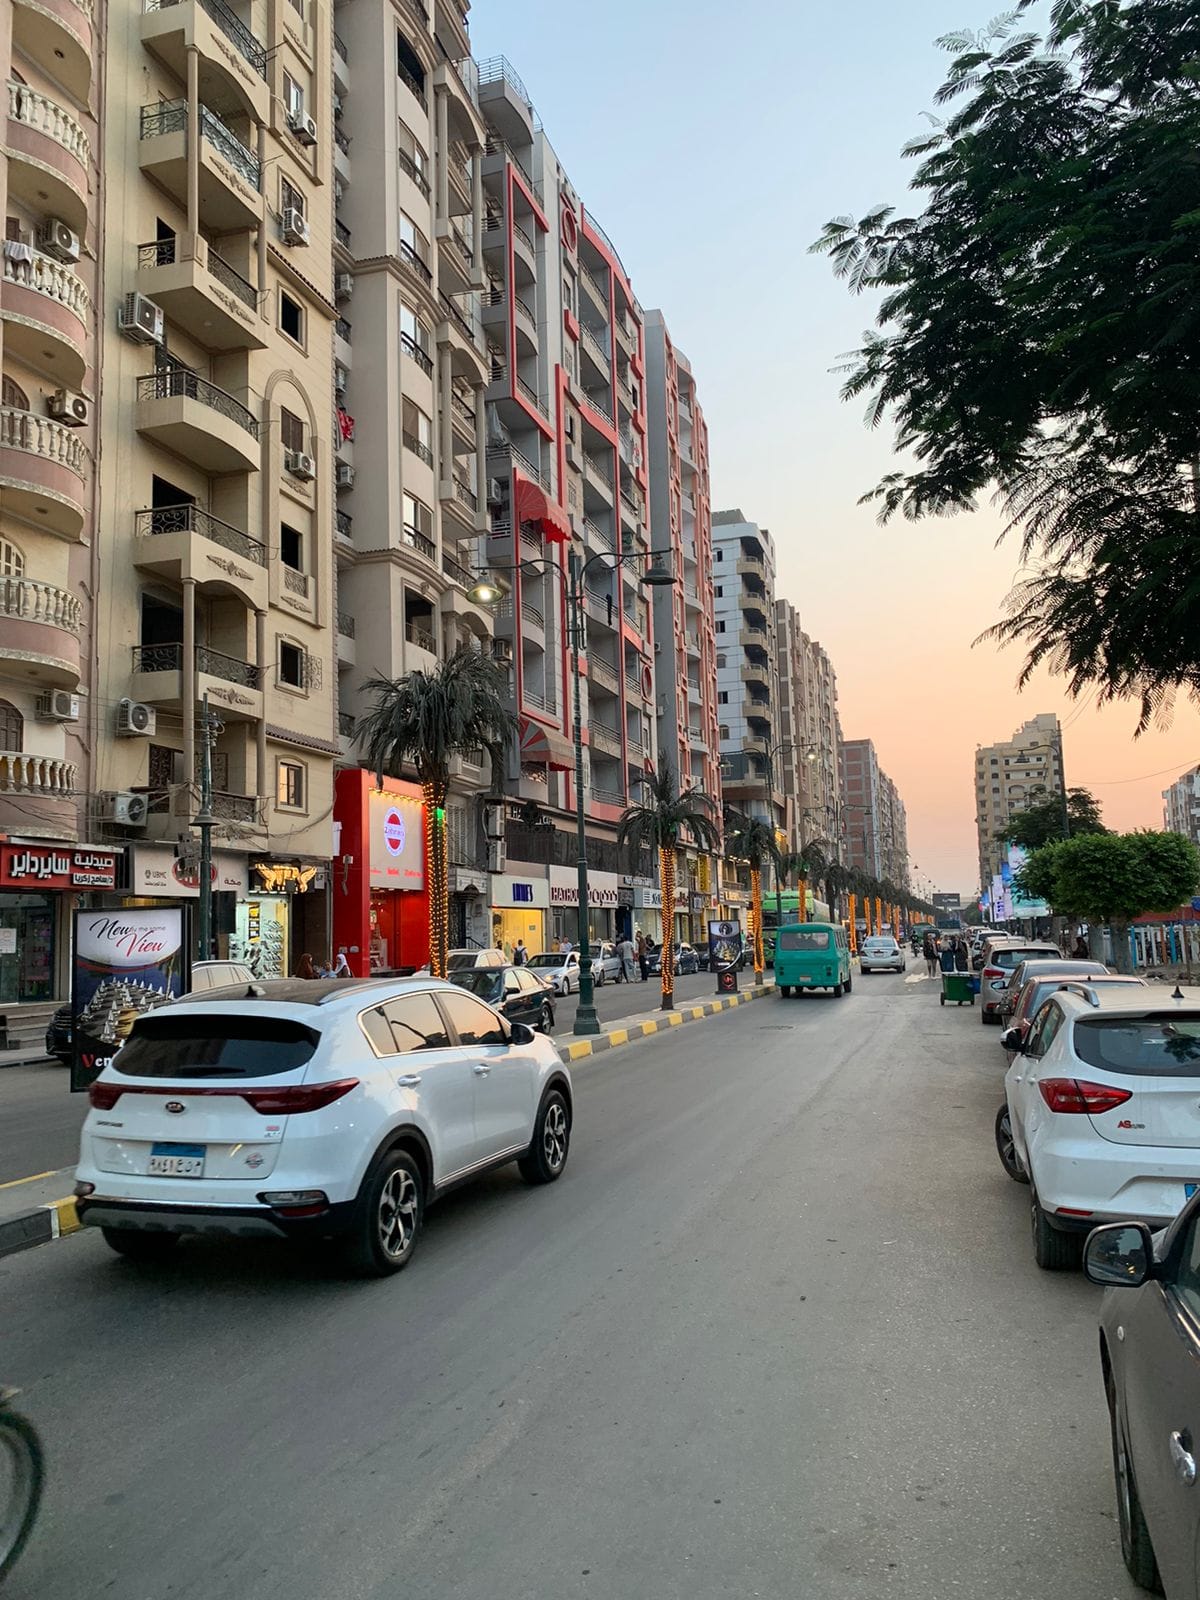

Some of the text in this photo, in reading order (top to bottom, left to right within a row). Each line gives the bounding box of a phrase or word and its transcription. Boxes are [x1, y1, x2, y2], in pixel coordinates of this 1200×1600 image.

[11, 851, 70, 878] سايرداير
[75, 853, 114, 869] صيدلية
[551, 887, 579, 902] HATHO
[89, 918, 132, 940] New
[116, 930, 166, 957] View
[82, 1054, 112, 1067] Ven
